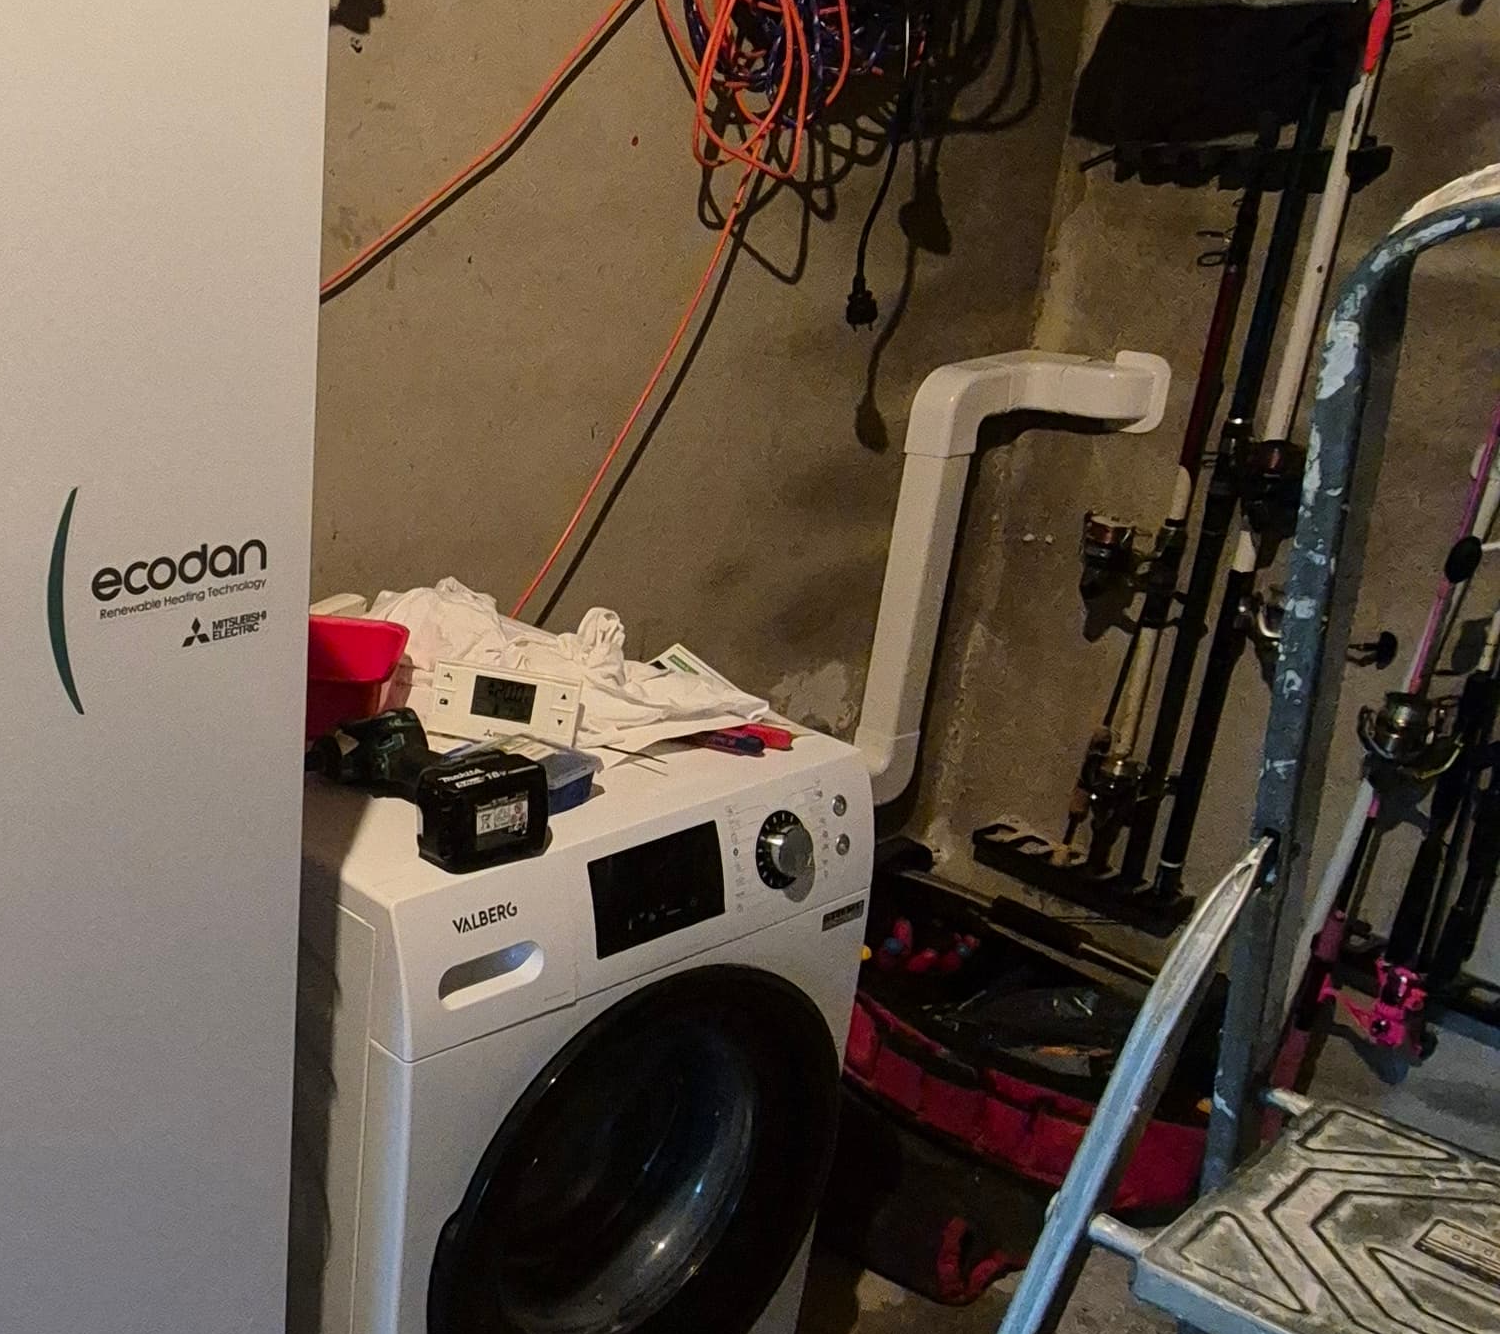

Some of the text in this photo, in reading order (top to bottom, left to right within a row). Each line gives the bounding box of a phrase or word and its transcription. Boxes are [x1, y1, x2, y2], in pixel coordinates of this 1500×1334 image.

[91, 539, 267, 601] ecodan
[99, 578, 267, 619] Renewable Heating Technology
[212, 610, 267, 630] MITSUBISHI
[212, 622, 260, 641] ELECTRIC
[452, 901, 518, 934] VALBERG
